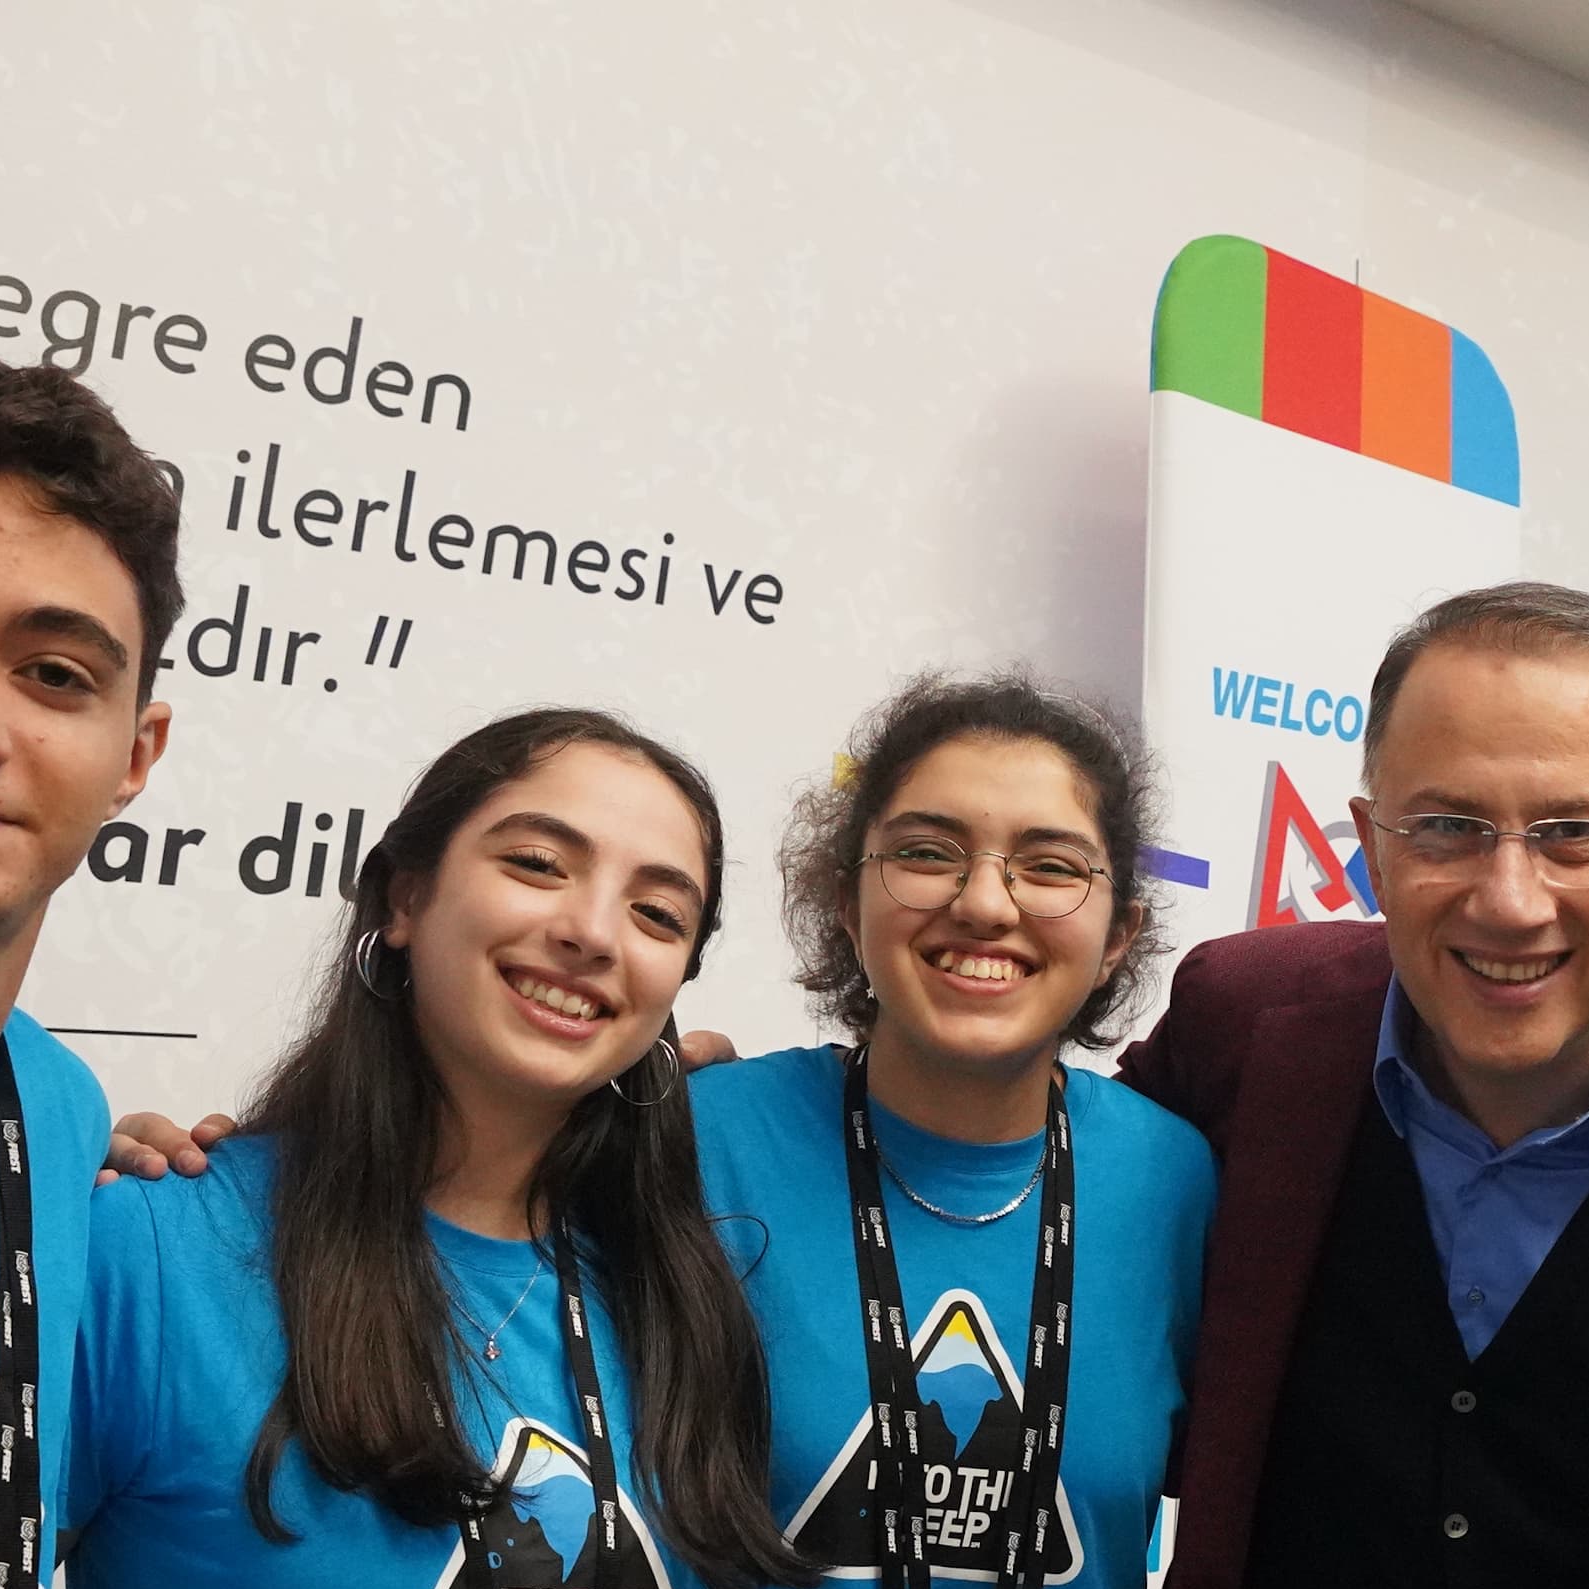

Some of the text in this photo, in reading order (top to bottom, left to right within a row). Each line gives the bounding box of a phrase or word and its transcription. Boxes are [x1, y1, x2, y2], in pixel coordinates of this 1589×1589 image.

[243, 316, 473, 432] eden
[223, 443, 787, 626] ilerlemesi ve
[1213, 667, 1364, 742] WELCO
[7, 1141, 21, 1174] FIRST
[873, 1224, 887, 1248] FIRST
[20, 1272, 32, 1305] FIRST
[871, 1317, 882, 1343] FIRST
[893, 1324, 905, 1349] FIRST
[1034, 1340, 1043, 1369] FIRST
[23, 1406, 34, 1439] FIRST
[589, 1411, 603, 1438] FIRST
[880, 1421, 892, 1448] FIRST
[907, 1427, 918, 1456] FIRST
[1, 1449, 11, 1482] FIRST
[1023, 1443, 1032, 1473] FIRST
[605, 1520, 616, 1550] FIRST
[885, 1525, 896, 1554] FIRST
[913, 1531, 923, 1561] FIRST
[1035, 1524, 1045, 1554] FIRST
[23, 1539, 34, 1574] FIRST
